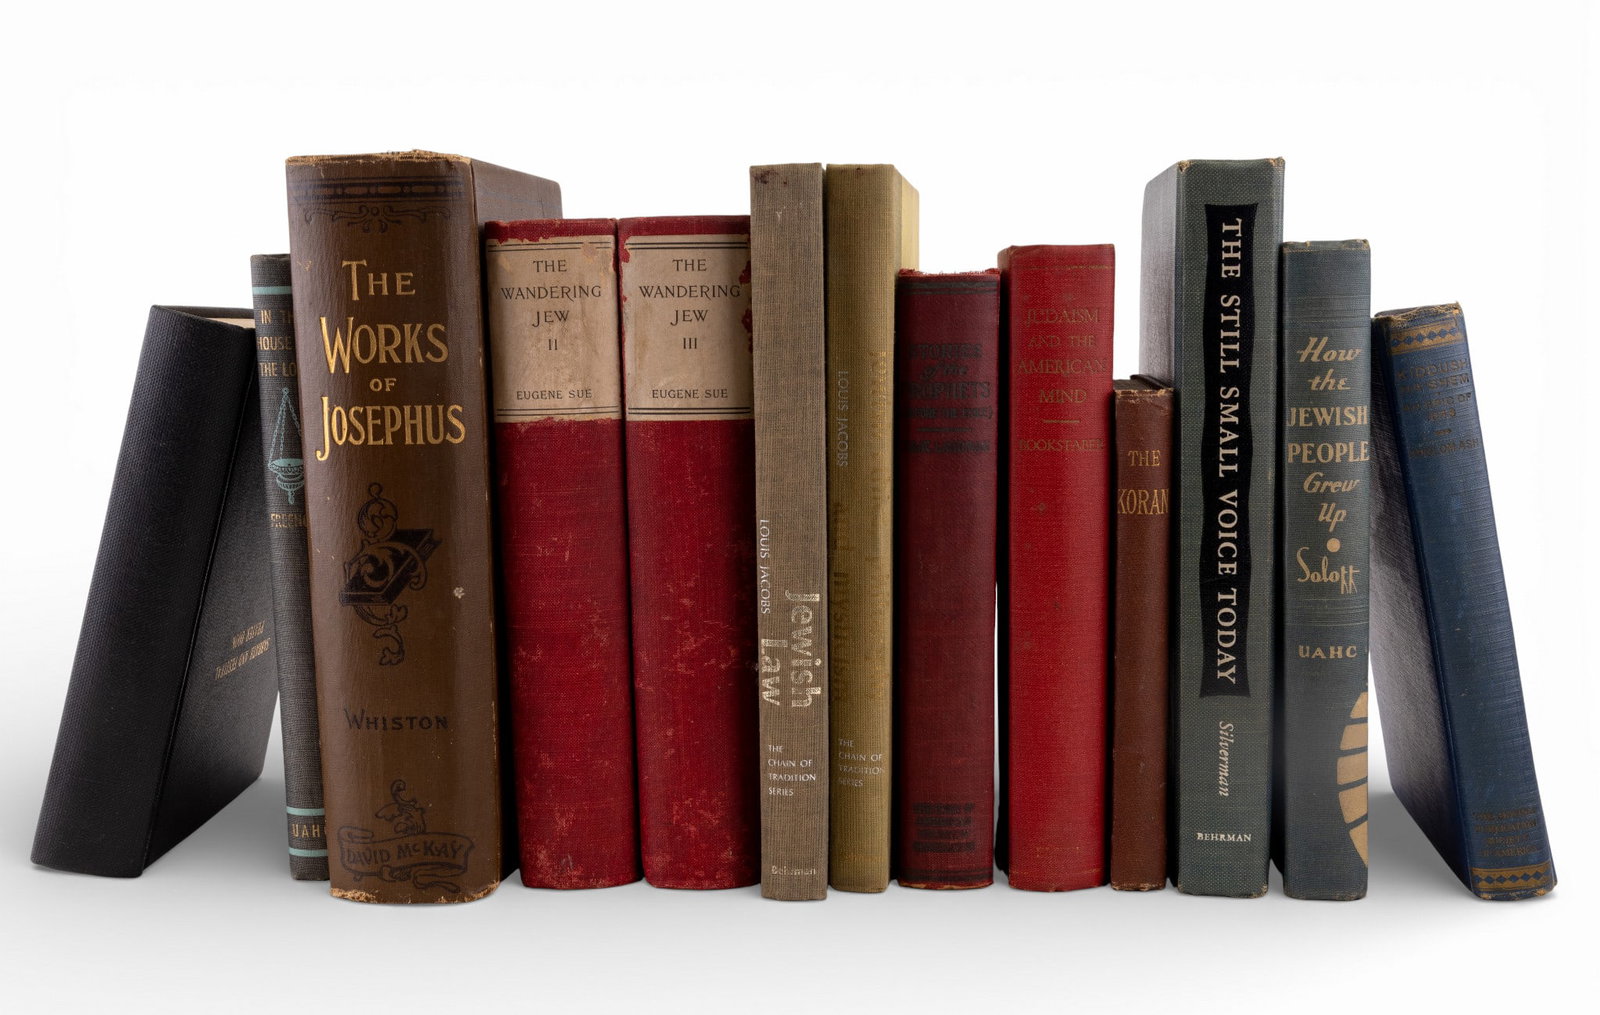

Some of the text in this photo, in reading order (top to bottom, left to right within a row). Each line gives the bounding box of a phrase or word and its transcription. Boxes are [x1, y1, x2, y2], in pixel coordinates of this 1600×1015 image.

[533, 260, 567, 272] THE
[673, 259, 707, 271] THE
[342, 259, 416, 301] THE
[501, 285, 602, 302] WANDERING
[639, 285, 740, 300] WANDERING
[261, 309, 272, 324] IN
[532, 310, 570, 327] JEW
[670, 310, 709, 326] JEW
[1026, 308, 1099, 327] JUDAISM
[257, 336, 293, 350] HOUSE
[320, 317, 449, 374] WORKS
[548, 339, 558, 350] II
[683, 338, 697, 349] III
[1028, 335, 1097, 347] AND THE
[1297, 336, 1362, 362] How
[259, 362, 277, 377] THE
[1017, 359, 1107, 376] AMERICAN
[369, 378, 397, 392] OF
[1308, 368, 1351, 391] the
[516, 389, 592, 400] EUGENE SUE
[652, 389, 728, 399] EUGENE SUE
[1039, 389, 1087, 404] MIND
[836, 371, 849, 467] LOUIS JACOBS
[1287, 405, 1368, 427] JEWISH
[315, 396, 466, 461] JOSEPHUS
[1128, 449, 1161, 467] THE
[1217, 218, 1242, 684] THE STILL SMALL VOICE TODAY
[1287, 440, 1370, 464] PEOPLE
[1303, 471, 1360, 493] Grew
[1117, 488, 1169, 515] KORAN
[1318, 502, 1347, 532] Up
[759, 519, 771, 615] LOUIS JACOBS
[785, 589, 821, 707] Jewish
[1299, 644, 1358, 659] UAHC
[761, 638, 788, 706] Law
[344, 708, 449, 731] WHISTON
[768, 744, 783, 753] THE
[839, 738, 854, 748] THE
[768, 759, 813, 768] CHAIN OF
[838, 752, 883, 762] CHAIN OF
[1218, 721, 1234, 797] Silverman
[768, 773, 816, 782] TRADITION
[768, 786, 794, 796] SERIES
[1197, 832, 1252, 842] BEHRMAN
[347, 849, 392, 865] DAVID
